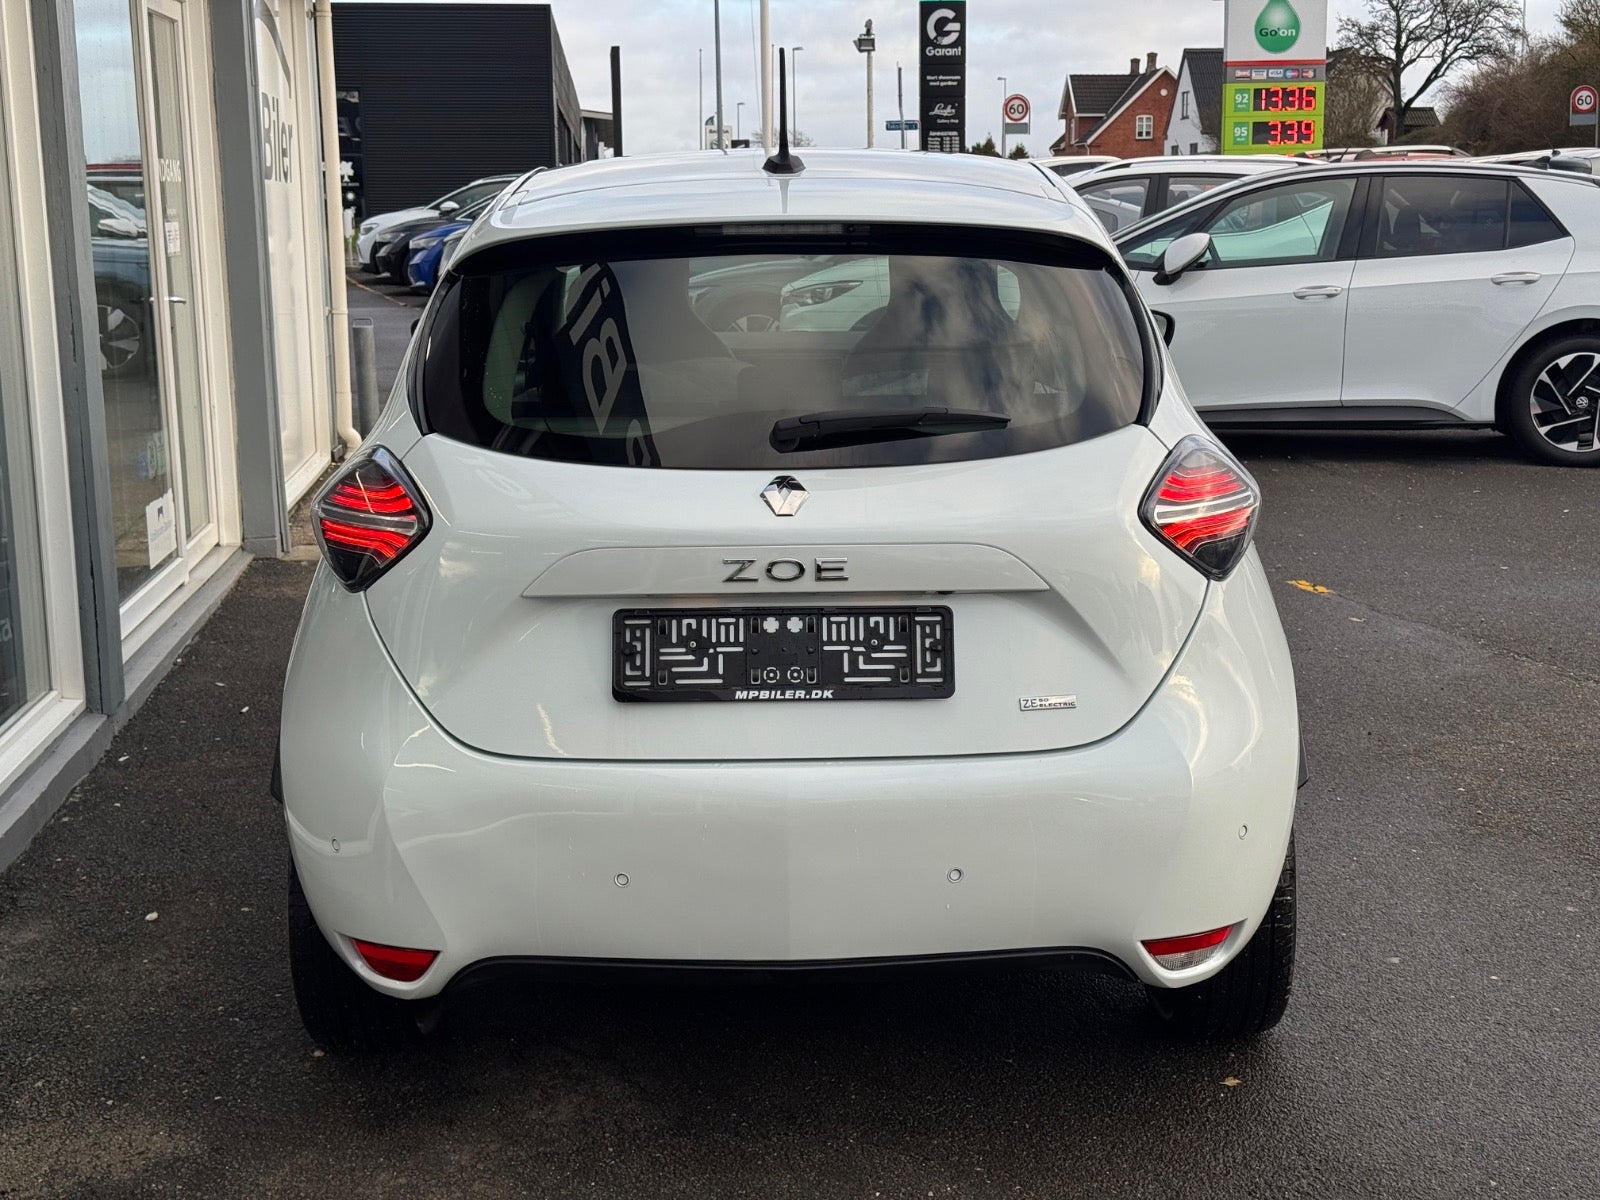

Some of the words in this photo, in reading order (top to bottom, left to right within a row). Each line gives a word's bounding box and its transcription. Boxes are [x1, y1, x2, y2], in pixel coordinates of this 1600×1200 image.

[926, 46, 962, 56] Garant
[1235, 93, 1249, 103] 92
[1261, 86, 1317, 112] 13.36
[1576, 94, 1592, 106] 60
[1009, 103, 1024, 115] 60
[261, 91, 293, 184] Biler
[1234, 127, 1248, 136] 95
[722, 557, 849, 583] ZOE
[734, 689, 835, 700] MPBILER.DK
[1022, 698, 1038, 709] ZE
